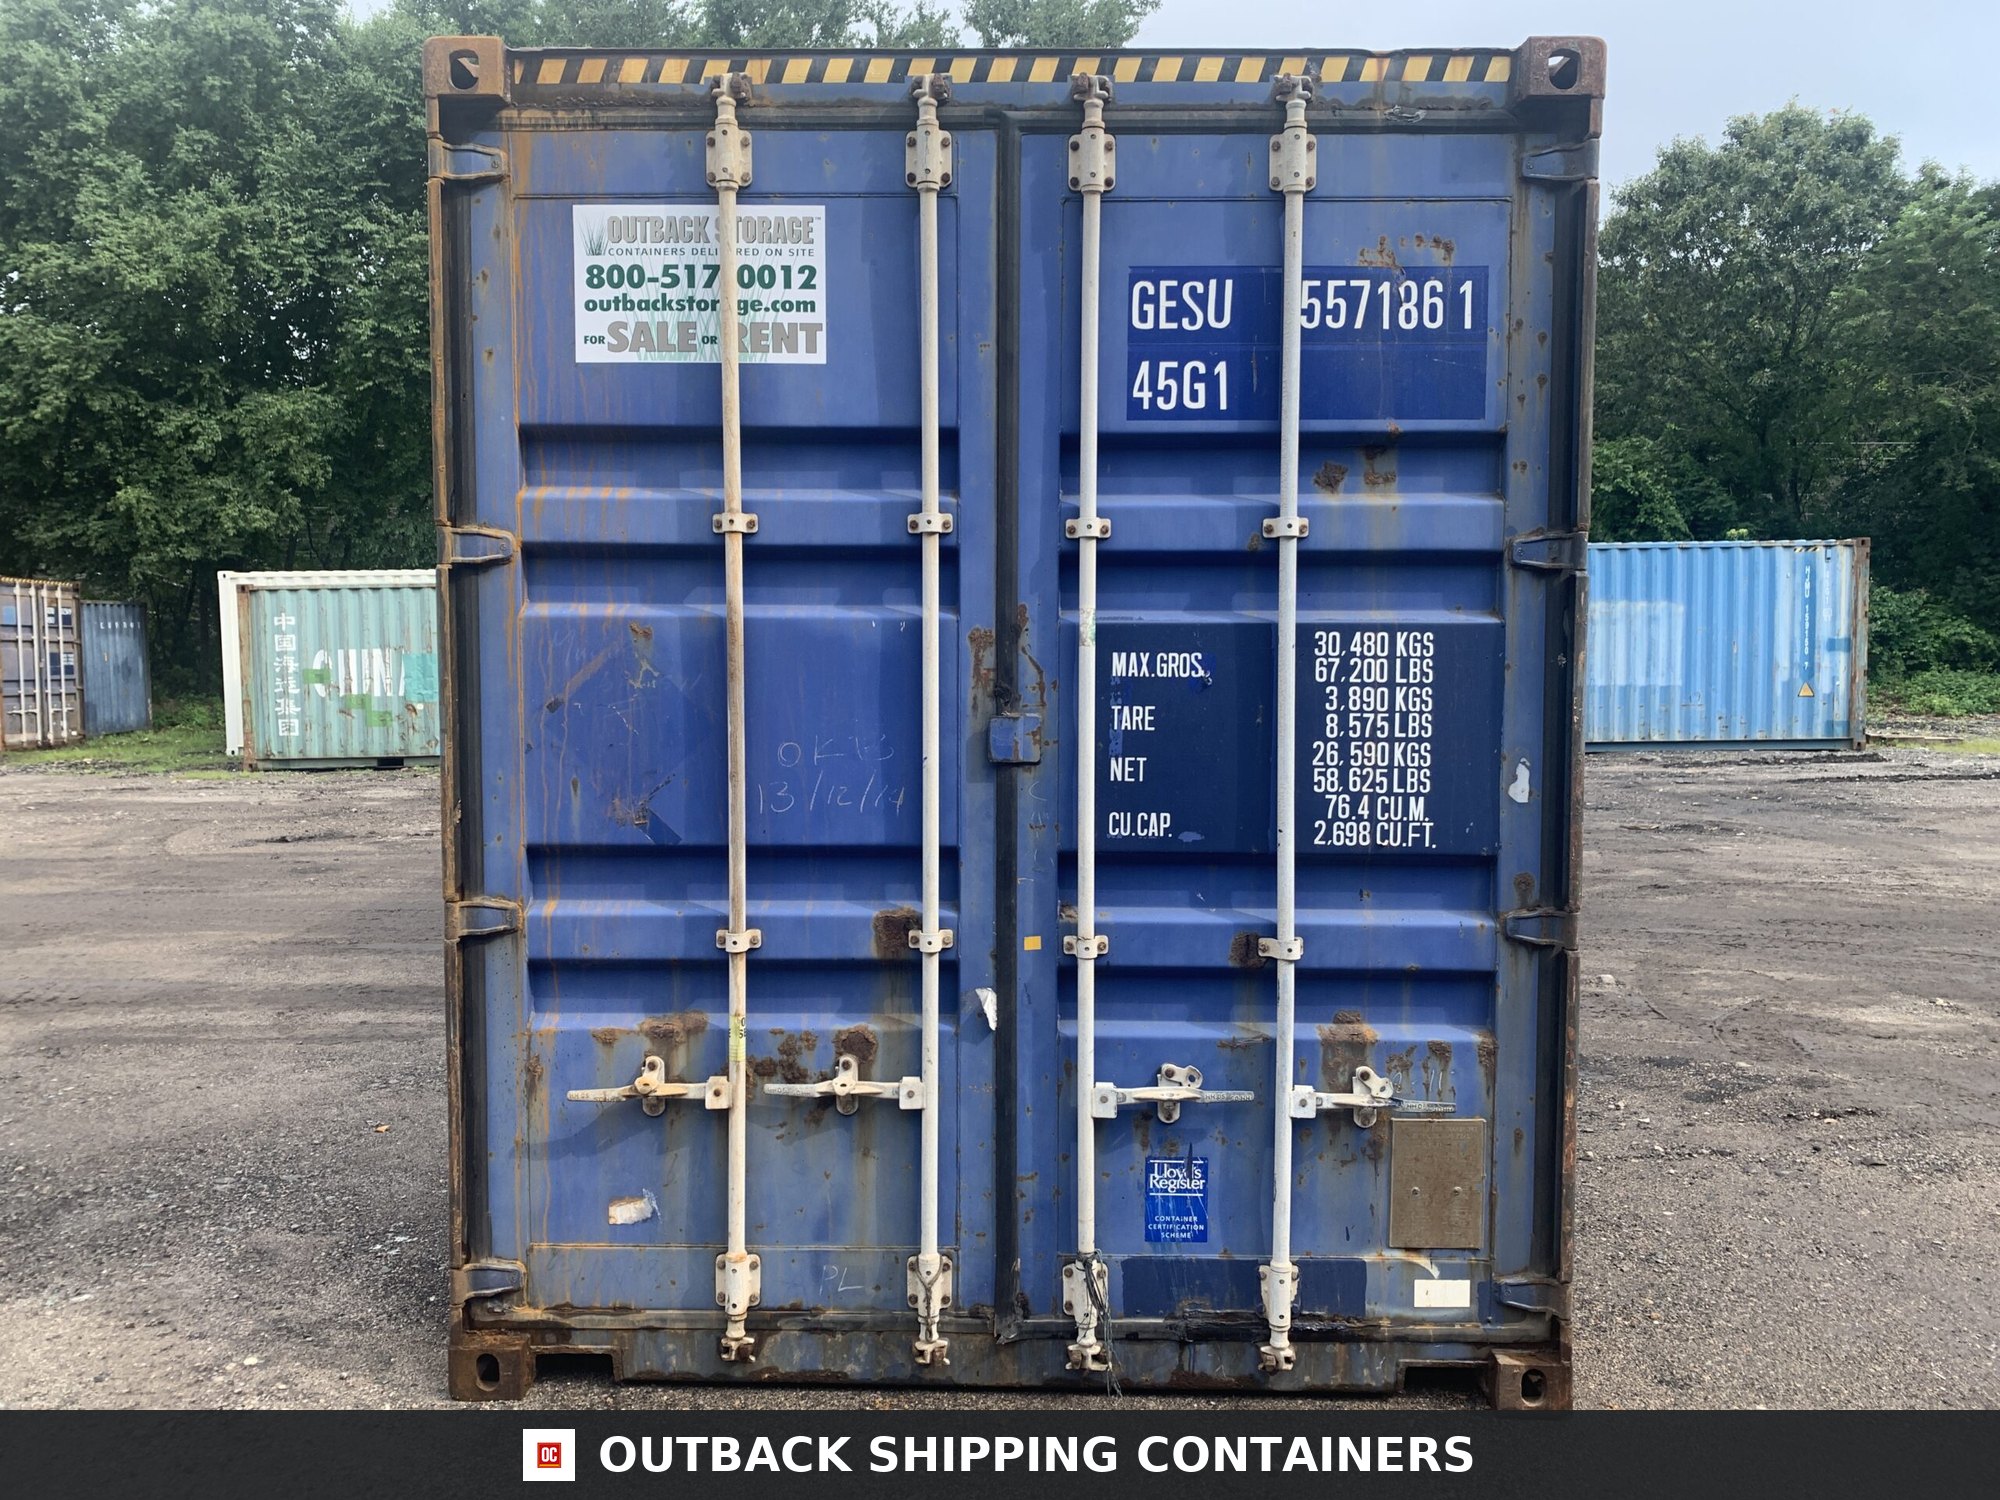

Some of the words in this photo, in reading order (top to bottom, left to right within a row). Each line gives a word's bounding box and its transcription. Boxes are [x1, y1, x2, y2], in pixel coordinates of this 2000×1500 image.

[607, 215, 711, 244] OUTBACK
[608, 247, 686, 256] CONTAINERS
[691, 247, 760, 257] DELIRED
[765, 248, 783, 257] ON
[788, 248, 815, 257] SITE
[585, 263, 818, 290] 800-5170012
[584, 293, 817, 316] outbackstorge.com
[1131, 278, 1233, 331] GESU
[584, 335, 605, 345] FOR
[607, 321, 698, 353] SALE
[701, 335, 718, 345] OR
[1132, 360, 1228, 411] 45G1
[1396, 631, 1434, 657] KGS
[312, 648, 405, 698] CHIN
[1315, 657, 1389, 683] 67,200
[1395, 658, 1434, 683] LBS
[1325, 686, 1389, 711] 3,890
[1394, 686, 1433, 712] KGS
[1111, 705, 1155, 731] TARE
[1326, 713, 1389, 738] 8,575
[1394, 712, 1432, 738] LBS
[1393, 741, 1431, 767] KGS
[1109, 756, 1147, 782] NET
[1392, 768, 1431, 793] LBS
[1325, 794, 1370, 820] 76.4
[1376, 796, 1430, 822] CU.M.
[1108, 811, 1173, 837] CU.CAP.
[1313, 820, 1371, 846] 2,698
[1376, 822, 1437, 849] CU.FT.
[1149, 1173, 1206, 1193] Register
[1147, 1223, 1205, 1231] CERTIFICATION
[1154, 1215, 1198, 1223] CONTAINER
[1160, 1231, 1192, 1239] SCHEME
